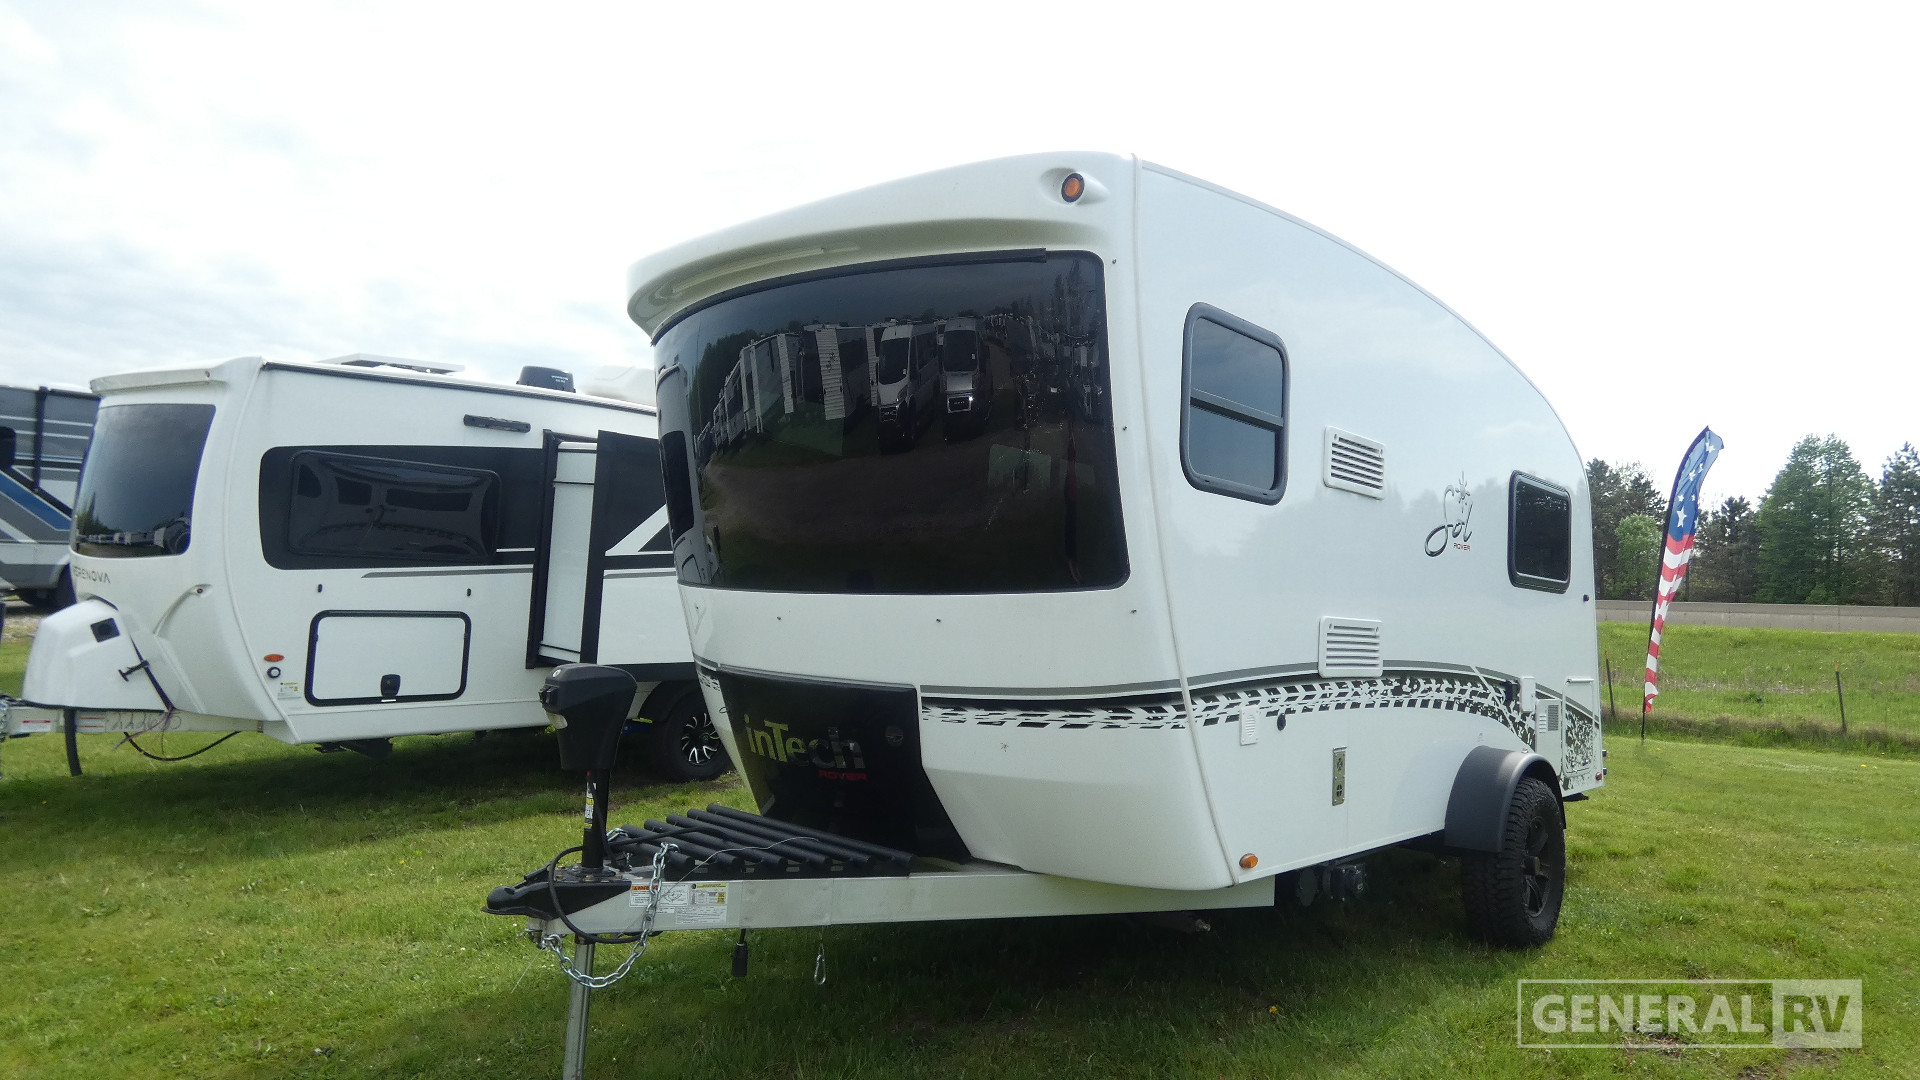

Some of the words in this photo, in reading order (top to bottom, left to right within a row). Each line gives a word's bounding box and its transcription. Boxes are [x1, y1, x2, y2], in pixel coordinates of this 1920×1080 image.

[1453, 542, 1471, 552] ROVER
[743, 713, 866, 769] inTech
[818, 769, 868, 781] ROVER
